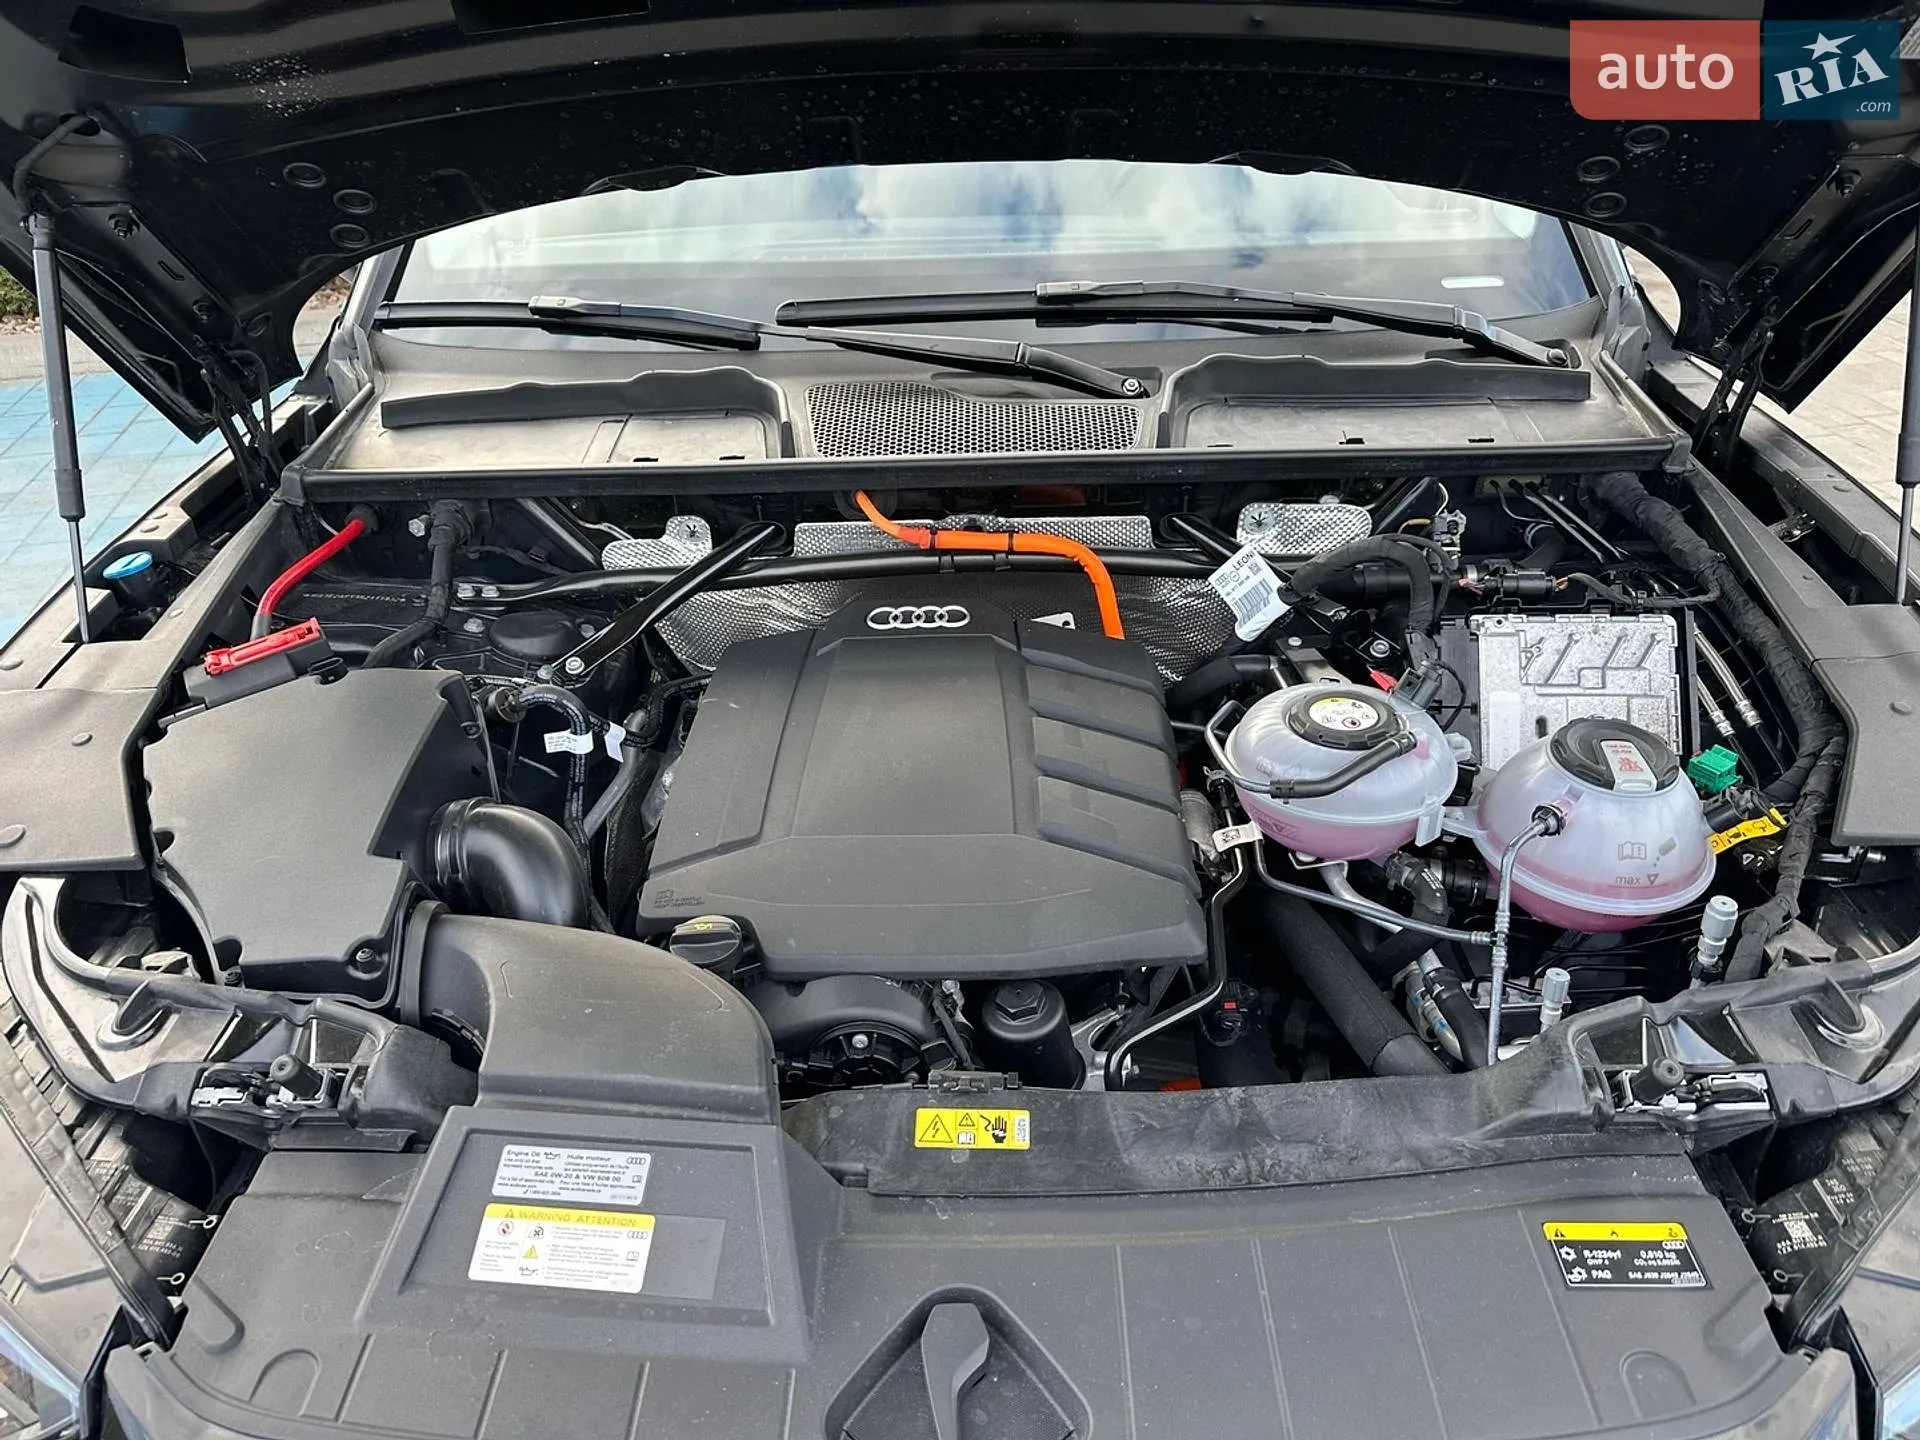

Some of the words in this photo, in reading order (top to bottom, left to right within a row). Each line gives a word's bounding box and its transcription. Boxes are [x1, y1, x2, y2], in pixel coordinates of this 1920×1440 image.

[1615, 876, 1641, 885] max
[507, 1149, 529, 1157] Engine
[519, 1210, 570, 1222] WARNING
[576, 1215, 636, 1227] ATTENTION
[1591, 1269, 1612, 1279] PAG
